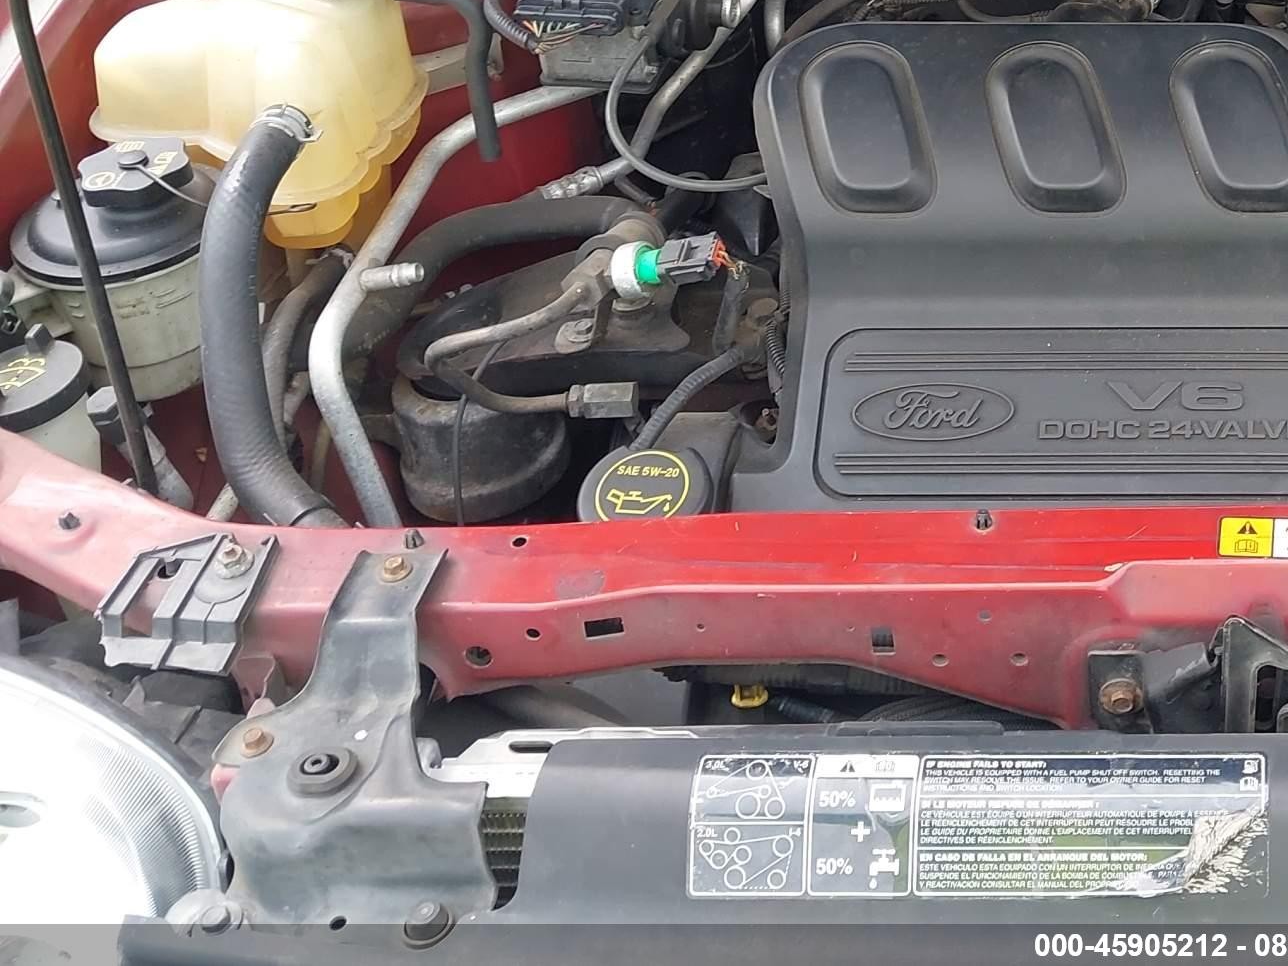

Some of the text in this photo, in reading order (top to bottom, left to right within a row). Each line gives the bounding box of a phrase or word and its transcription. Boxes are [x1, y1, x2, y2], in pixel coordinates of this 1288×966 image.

[1107, 380, 1244, 411] V6
[883, 390, 982, 429] Ford
[1039, 420, 1141, 440] DOHC
[617, 466, 680, 477] SAE 5W-20
[926, 760, 936, 769] IF
[937, 760, 971, 769] ENGINE
[973, 760, 999, 769] FAILS
[1000, 760, 1014, 769] TO
[818, 791, 856, 808] 50%
[1008, 819, 1019, 827] DE
[1020, 819, 1036, 827] CET
[1036, 819, 1094, 827] INTERRUPTEUR
[1094, 819, 1115, 827] PEUT
[1158, 819, 1169, 827] LE
[1169, 819, 1195, 827] PROBL
[697, 829, 718, 837] 2.0L
[931, 827, 956, 835] GUIDE
[956, 827, 968, 835] DU
[1024, 827, 1051, 835] DONNE
[1114, 827, 1125, 835] DE
[1126, 827, 1141, 835] CET
[920, 836, 965, 844] DIRECTIVES
[965, 836, 976, 844] DE
[919, 853, 933, 861] EN
[934, 853, 961, 861] CASO
[962, 853, 976, 861] DE
[977, 853, 1006, 861] FALLA
[1007, 853, 1021, 861] EN
[1022, 853, 1035, 861] EL
[1036, 853, 1088, 861] ARRANQUE
[1090, 853, 1109, 861] DEL
[816, 858, 853, 875] 50%
[920, 863, 939, 871] ESTE
[999, 863, 1038, 871] EQUIPADO
[1039, 863, 1055, 871] CON
[1069, 863, 1122, 871] INTERRUPTOR
[1123, 863, 1134, 871] DE
[920, 872, 959, 880] SUSPENDE
[972, 872, 1038, 880] FUNCIONAMIENTO
[1038, 872, 1050, 880] DE
[1051, 872, 1061, 880] LA
[1061, 872, 1089, 880] BOMBA
[1090, 872, 1101, 880] DE
[981, 881, 1026, 889] CONSULTAR
[1037, 881, 1068, 889] MANUAL
[1069, 881, 1084, 889] DEL
